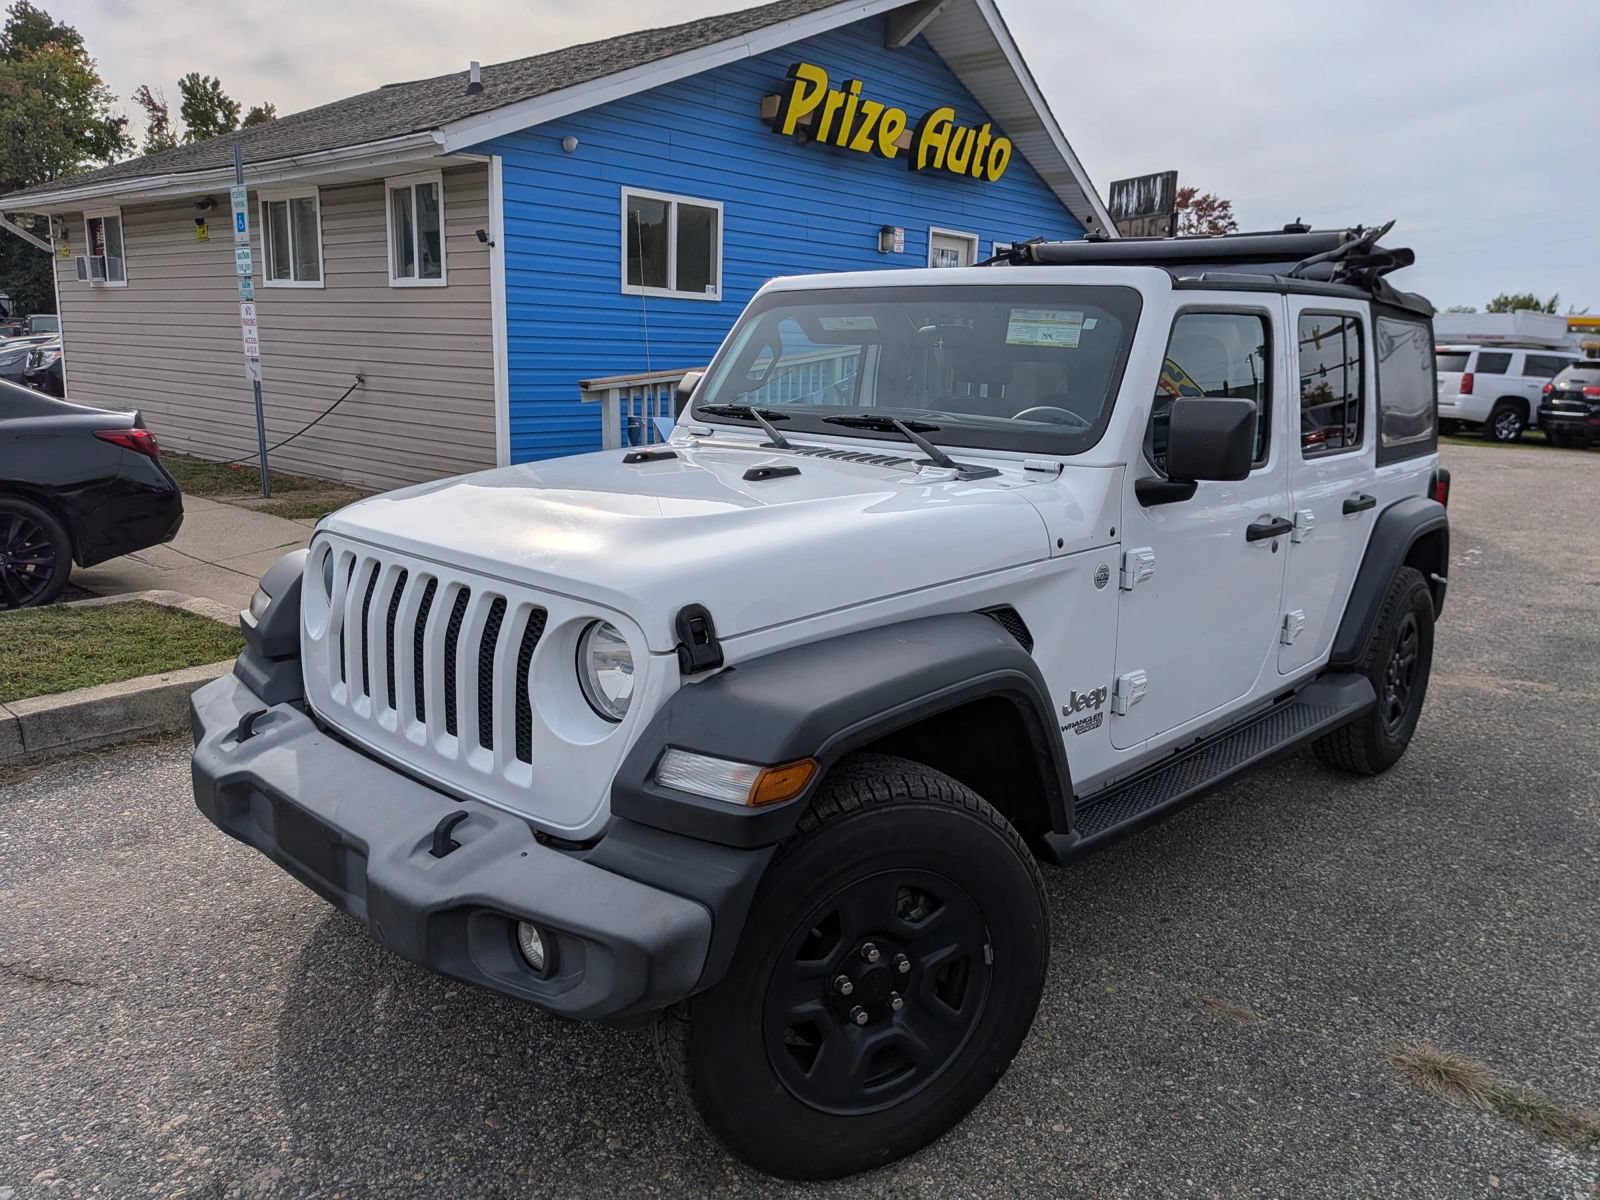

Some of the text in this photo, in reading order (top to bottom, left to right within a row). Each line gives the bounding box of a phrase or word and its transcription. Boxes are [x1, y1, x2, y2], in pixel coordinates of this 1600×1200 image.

[780, 62, 1013, 183] Prize Auto
[1062, 685, 1107, 717] Jeep
[1061, 711, 1104, 732] WRANGLER
